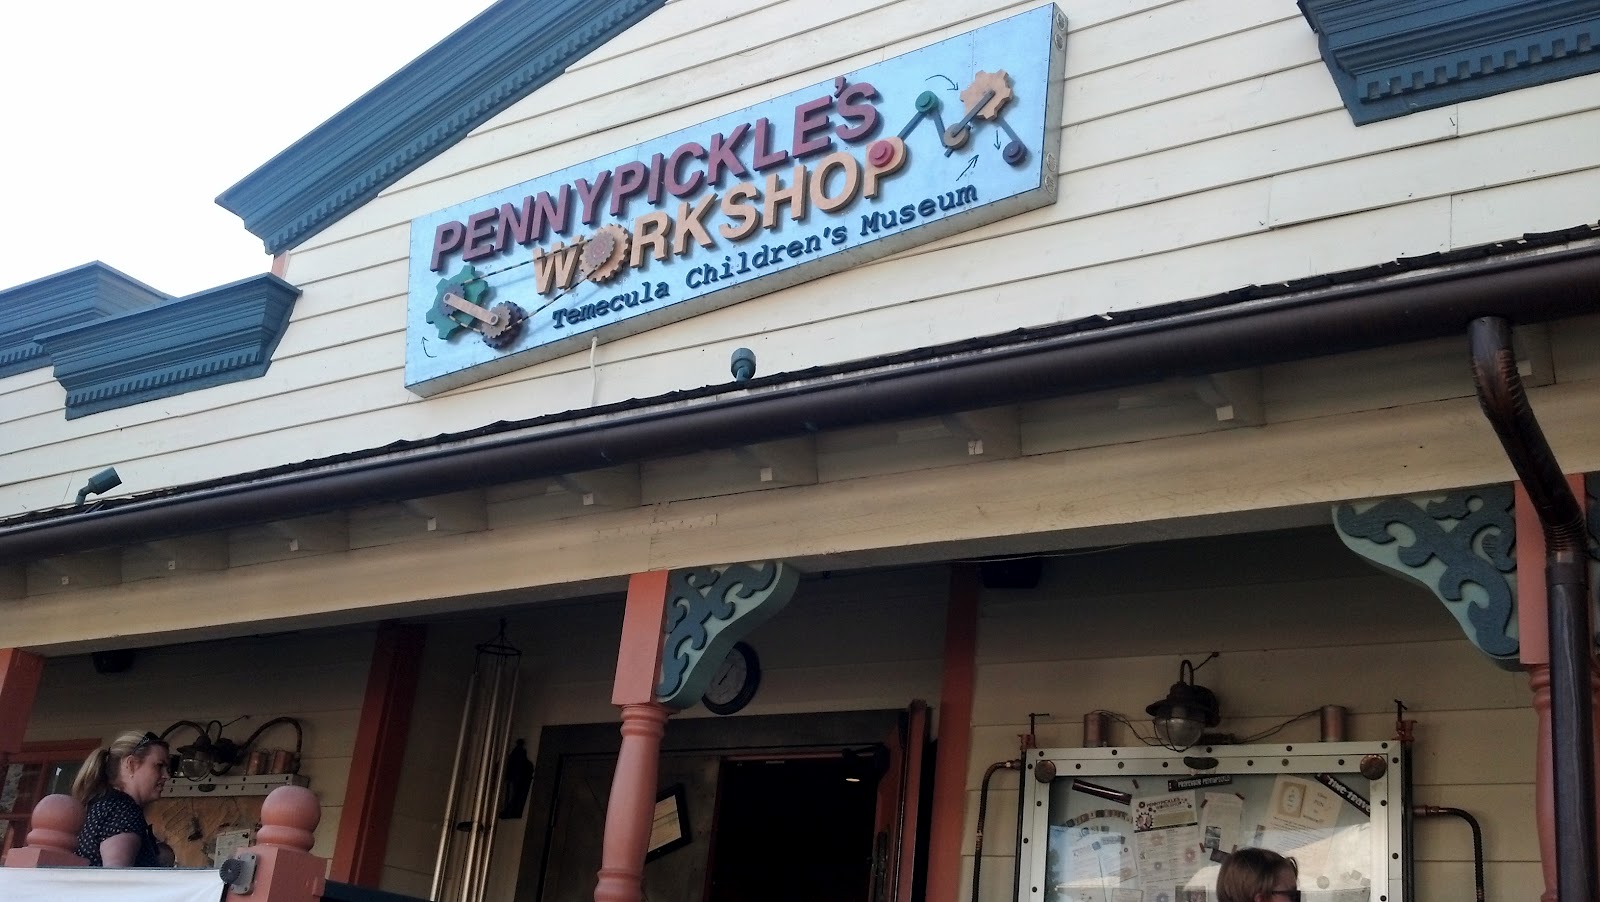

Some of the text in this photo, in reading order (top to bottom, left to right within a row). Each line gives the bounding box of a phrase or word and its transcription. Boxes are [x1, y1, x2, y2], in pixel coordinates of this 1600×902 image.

[429, 76, 880, 273] PENNYPICKLE'S
[532, 136, 907, 296] WORKSHOP
[552, 184, 979, 330] Temecula Children's Museum
